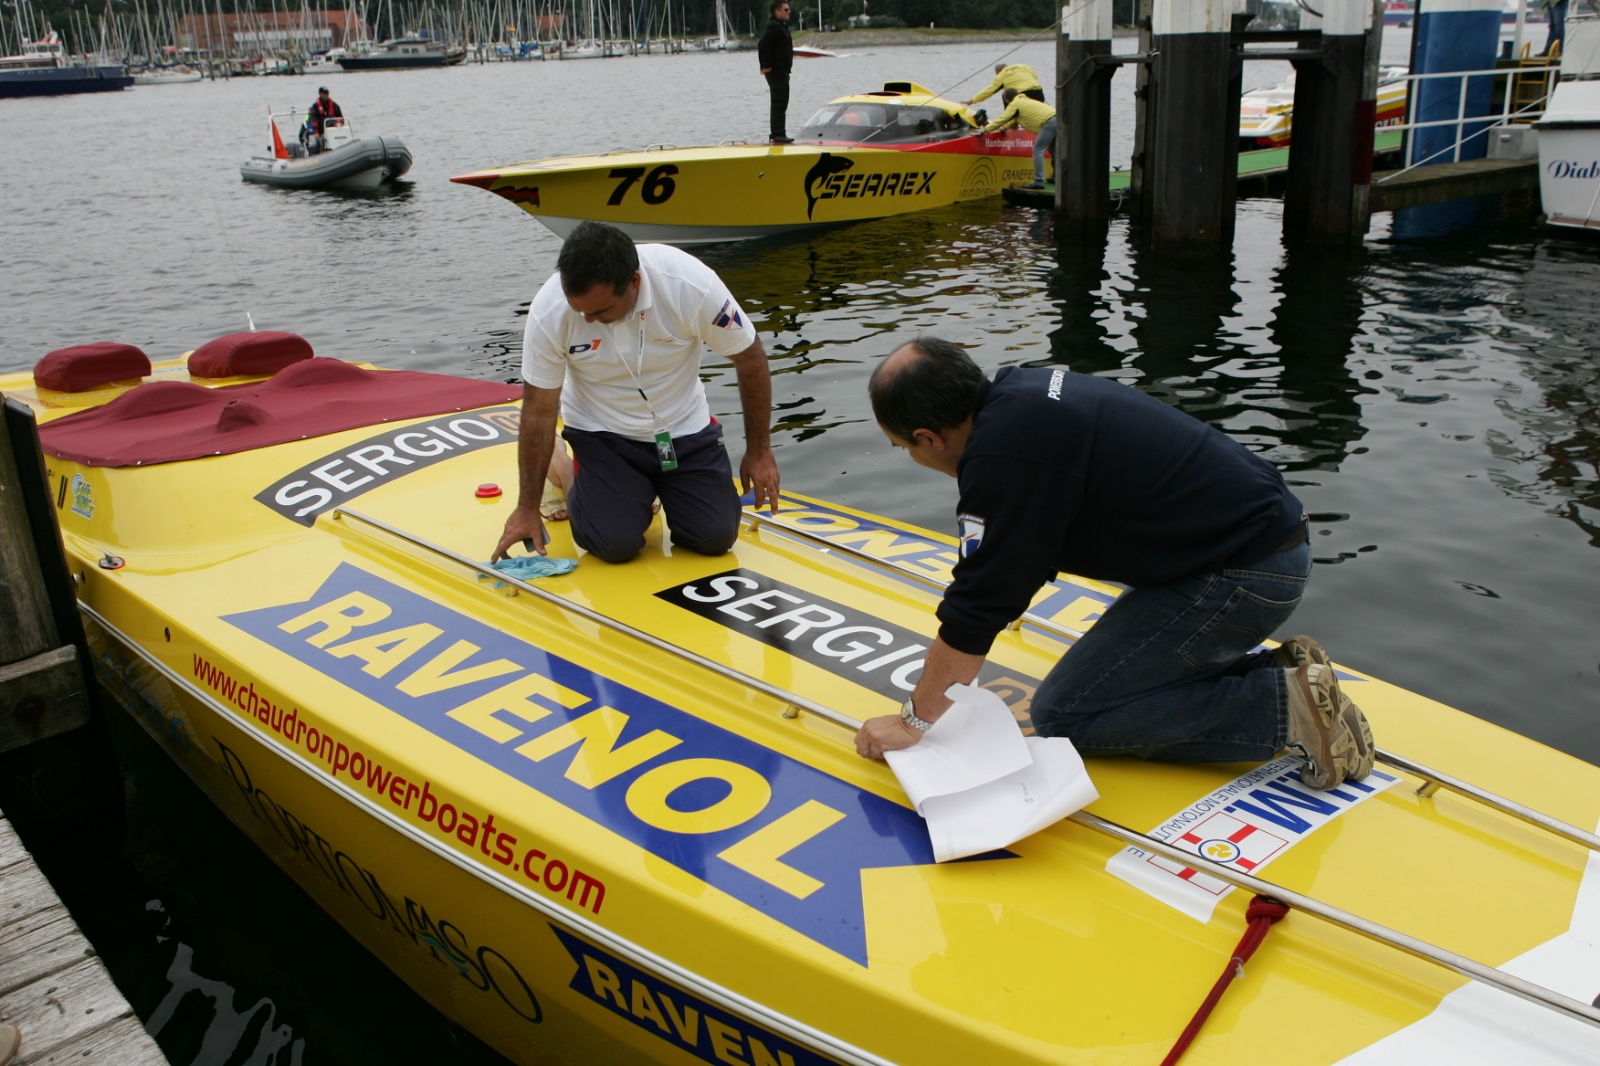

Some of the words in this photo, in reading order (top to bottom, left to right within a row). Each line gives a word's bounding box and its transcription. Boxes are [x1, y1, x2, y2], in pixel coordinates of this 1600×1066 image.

[607, 164, 679, 206] 76
[820, 172, 937, 199] SEAREX
[275, 417, 499, 517] SERGIO
[193, 653, 606, 914] www.chaudronpowerboats.com
[277, 590, 848, 900] RAVENOL
